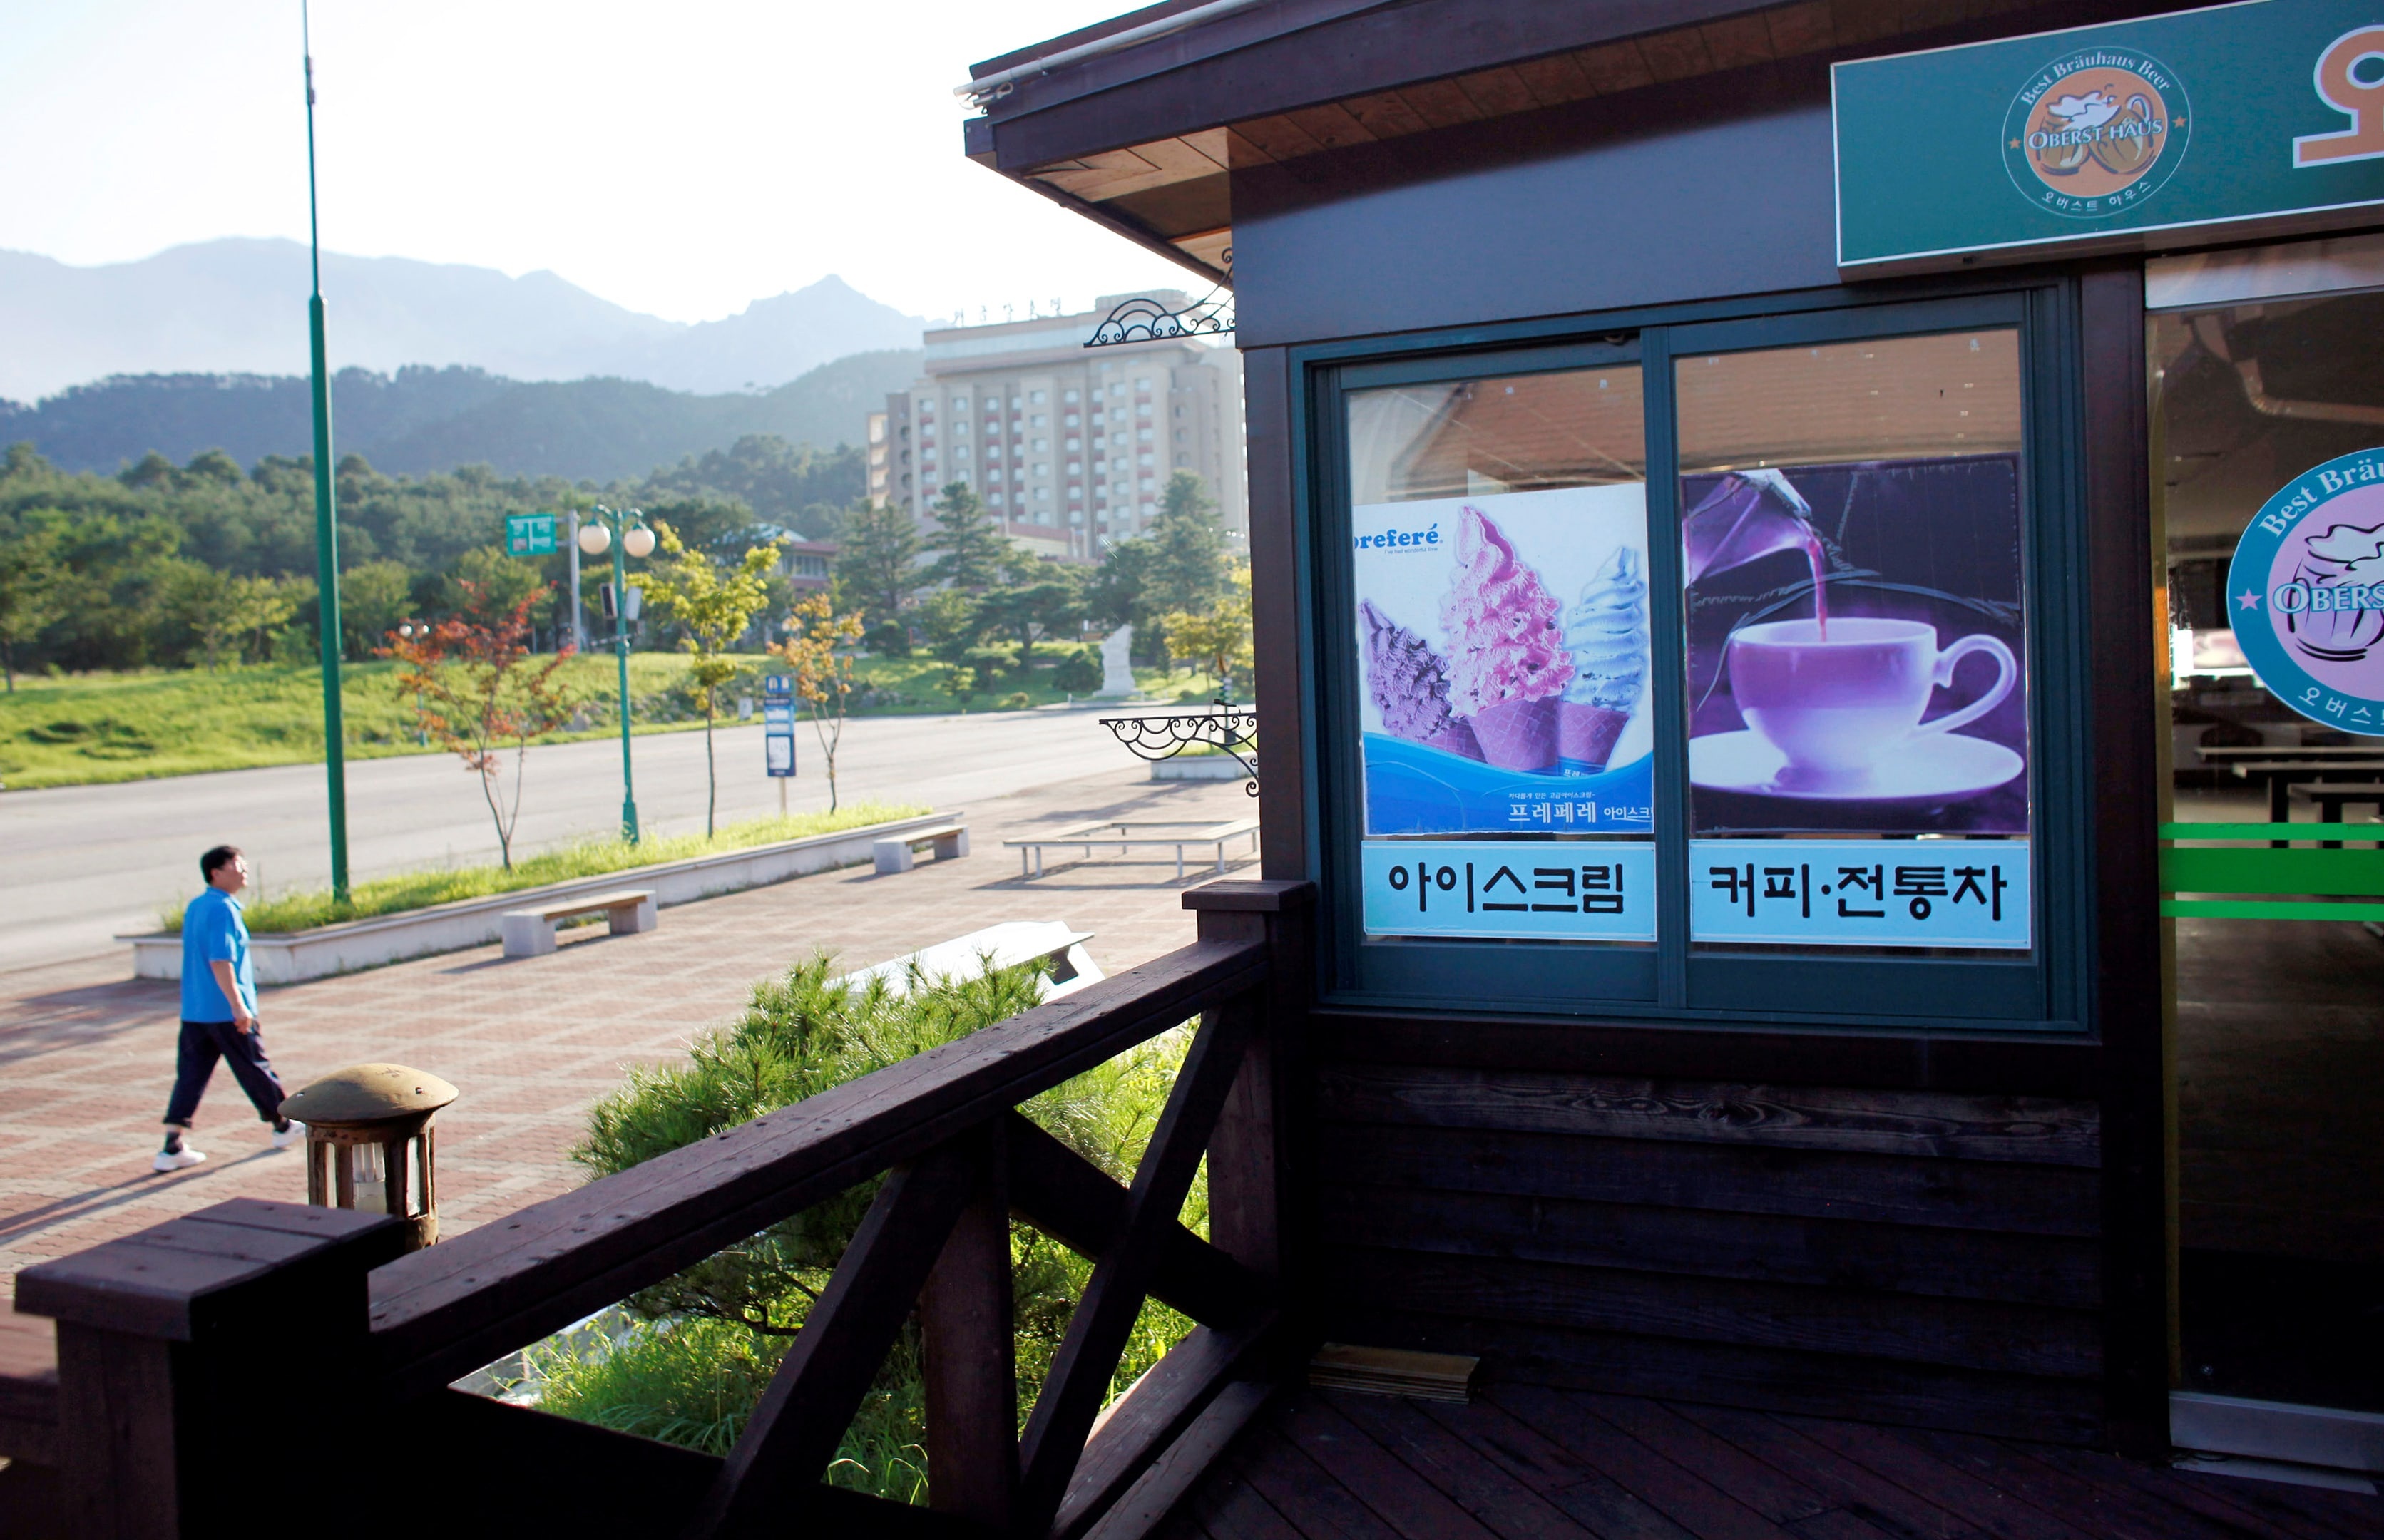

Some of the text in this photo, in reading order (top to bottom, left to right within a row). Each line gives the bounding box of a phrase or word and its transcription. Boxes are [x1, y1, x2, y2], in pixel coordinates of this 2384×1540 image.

[2021, 52, 2170, 106] Best Bräuhaus Beer
[2028, 127, 2104, 149] OBERST
[2042, 181, 2152, 211] 오버스트 하우스
[2258, 486, 2318, 538] Best
[1354, 523, 1439, 549] referé
[2298, 687, 2384, 726] 오버스
[1508, 801, 1654, 823] 프레페레 아이스크
[1388, 861, 1624, 914] 아이스크림
[1709, 863, 2007, 922] 커피·전통차
